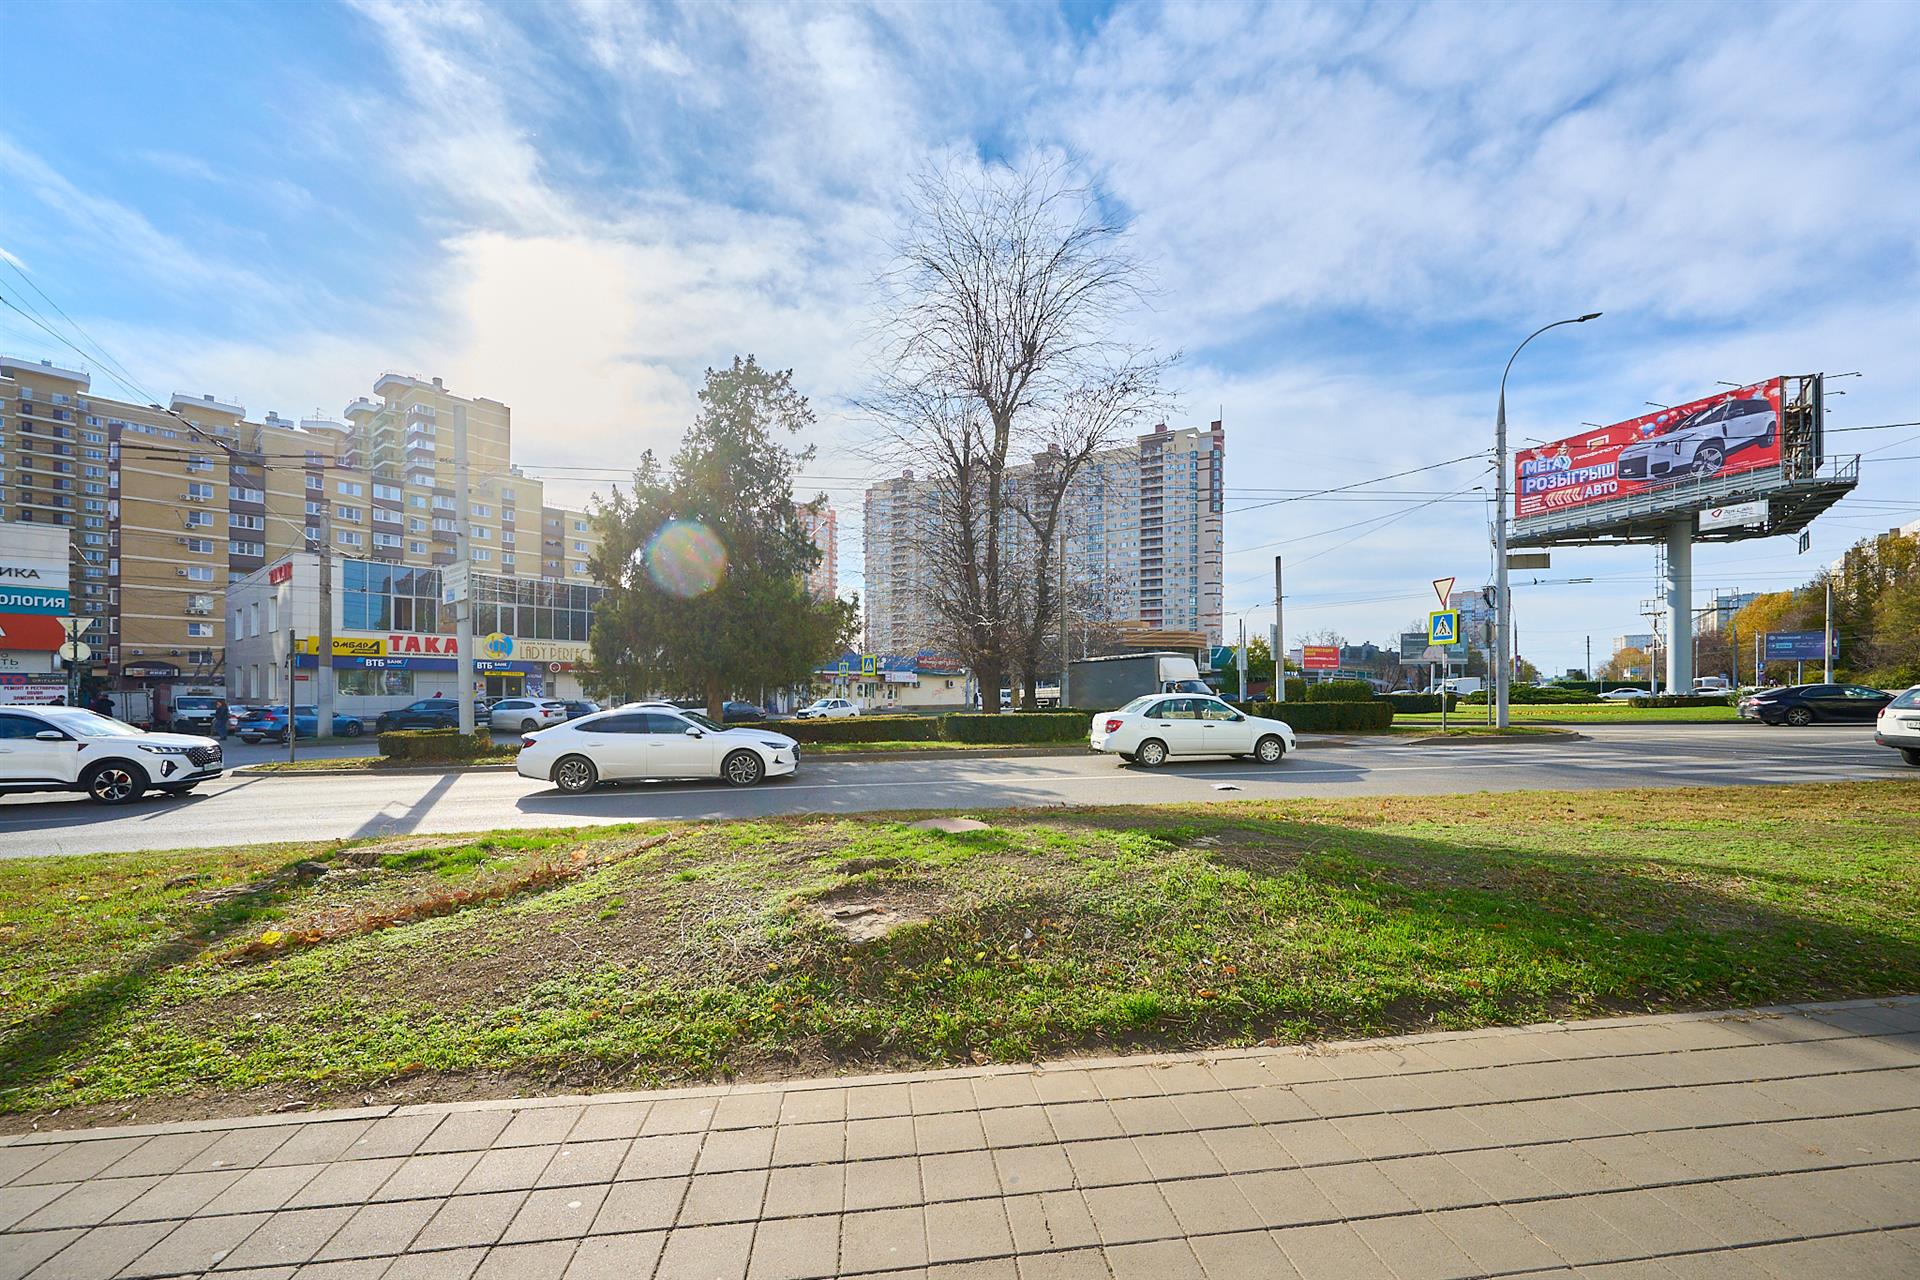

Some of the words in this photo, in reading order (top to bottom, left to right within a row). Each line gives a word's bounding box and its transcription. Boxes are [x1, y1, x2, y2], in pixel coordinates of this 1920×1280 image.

[1525, 457, 1561, 475] МЕГА
[1525, 462, 1616, 493] РОЗЫГРЫШ
[1584, 481, 1618, 498] АВТО
[0, 594, 66, 608] ОЛОГИЯ
[520, 645, 546, 660] LADY
[365, 658, 385, 667] ВТБ
[476, 661, 493, 670] ВТБ
